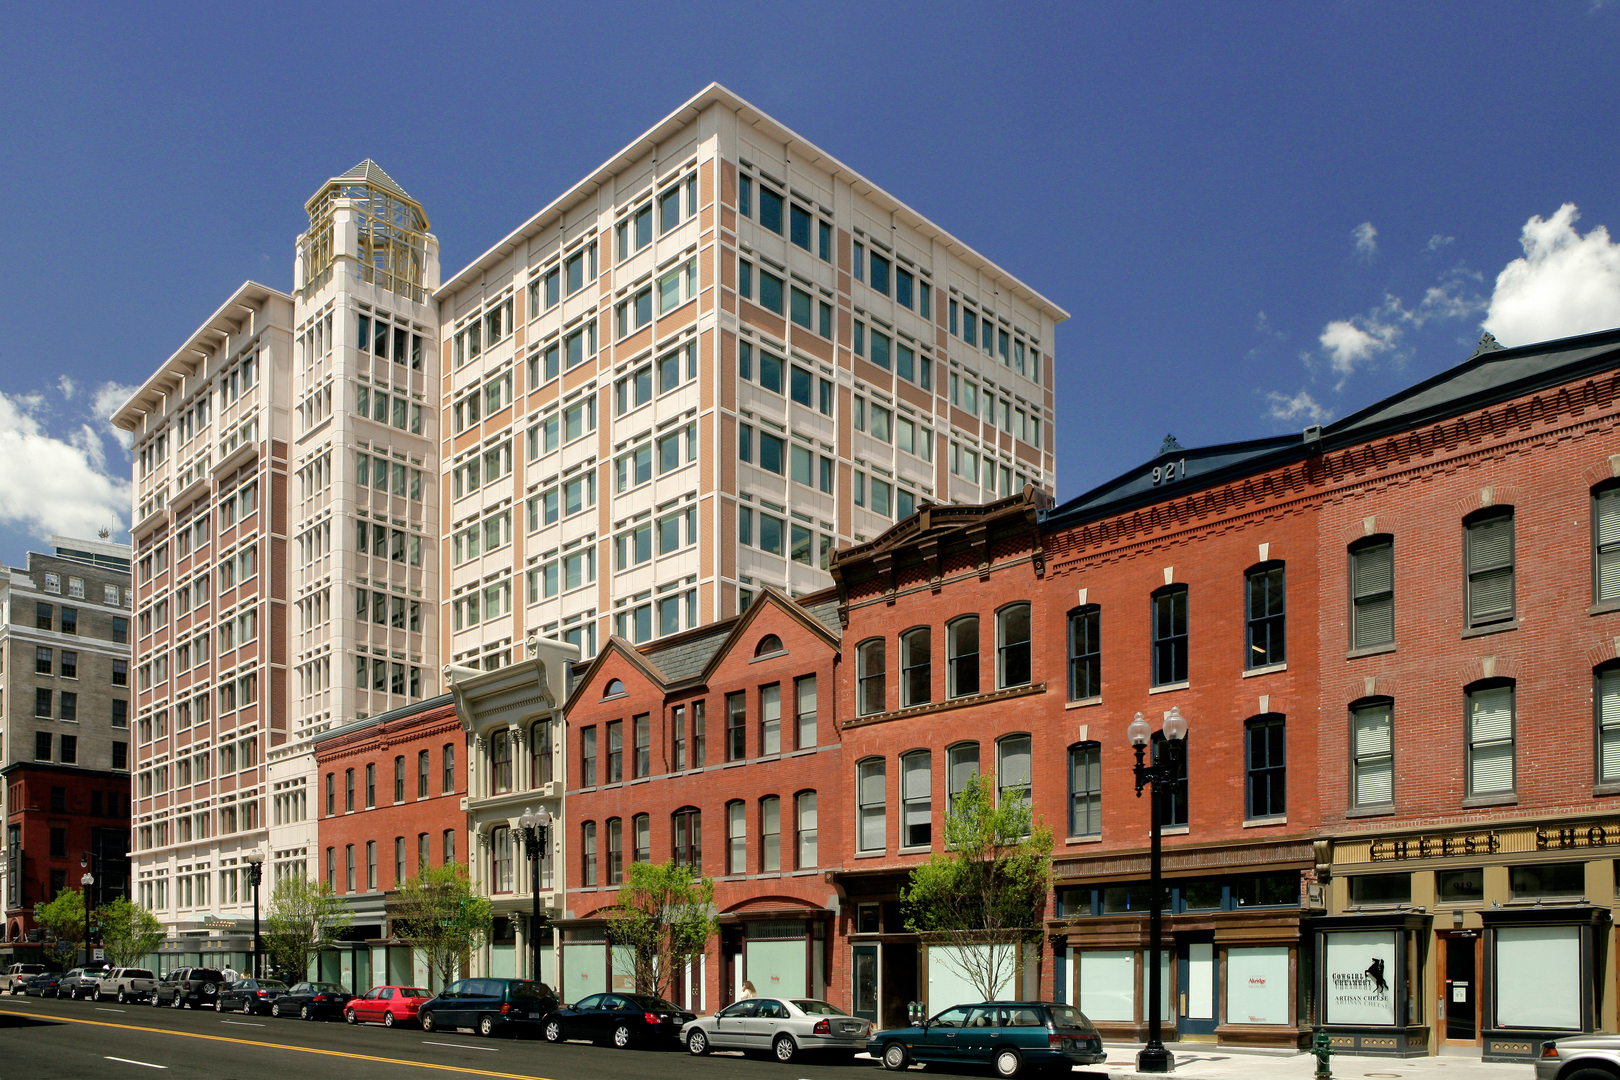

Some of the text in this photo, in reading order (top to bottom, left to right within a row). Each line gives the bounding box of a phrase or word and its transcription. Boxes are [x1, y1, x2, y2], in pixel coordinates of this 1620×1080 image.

[1152, 458, 1185, 483] 921
[1370, 826, 1606, 857] CHEESE SHO
[1453, 881, 1472, 891] 919
